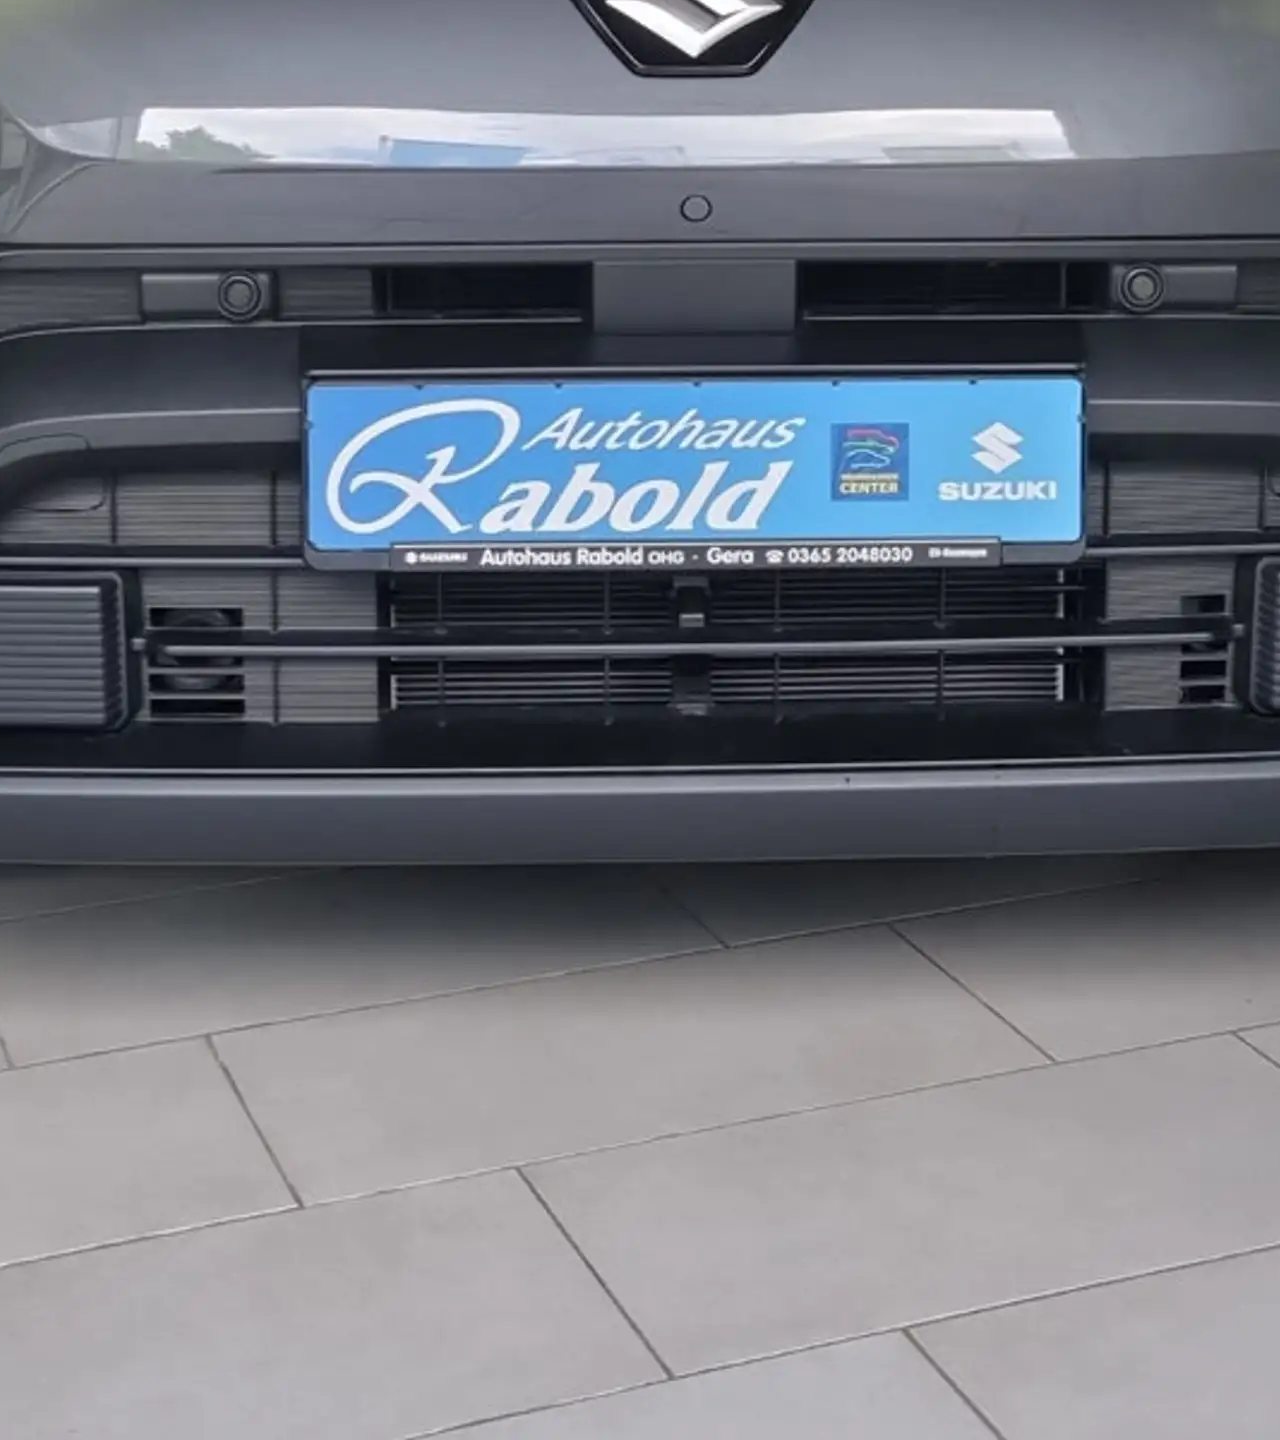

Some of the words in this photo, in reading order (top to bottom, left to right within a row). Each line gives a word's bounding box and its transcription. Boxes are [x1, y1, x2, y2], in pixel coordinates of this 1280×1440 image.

[521, 407, 807, 451] Autohaus
[326, 398, 794, 534] Rabold
[839, 482, 899, 495] CENTER
[938, 481, 1058, 501] SUZUKI
[480, 548, 572, 566] Autohaus
[576, 547, 643, 565] Rabold
[647, 551, 685, 565] OHG
[706, 547, 754, 565] Gera
[787, 547, 832, 563] 0365
[836, 546, 914, 563] 2048030
